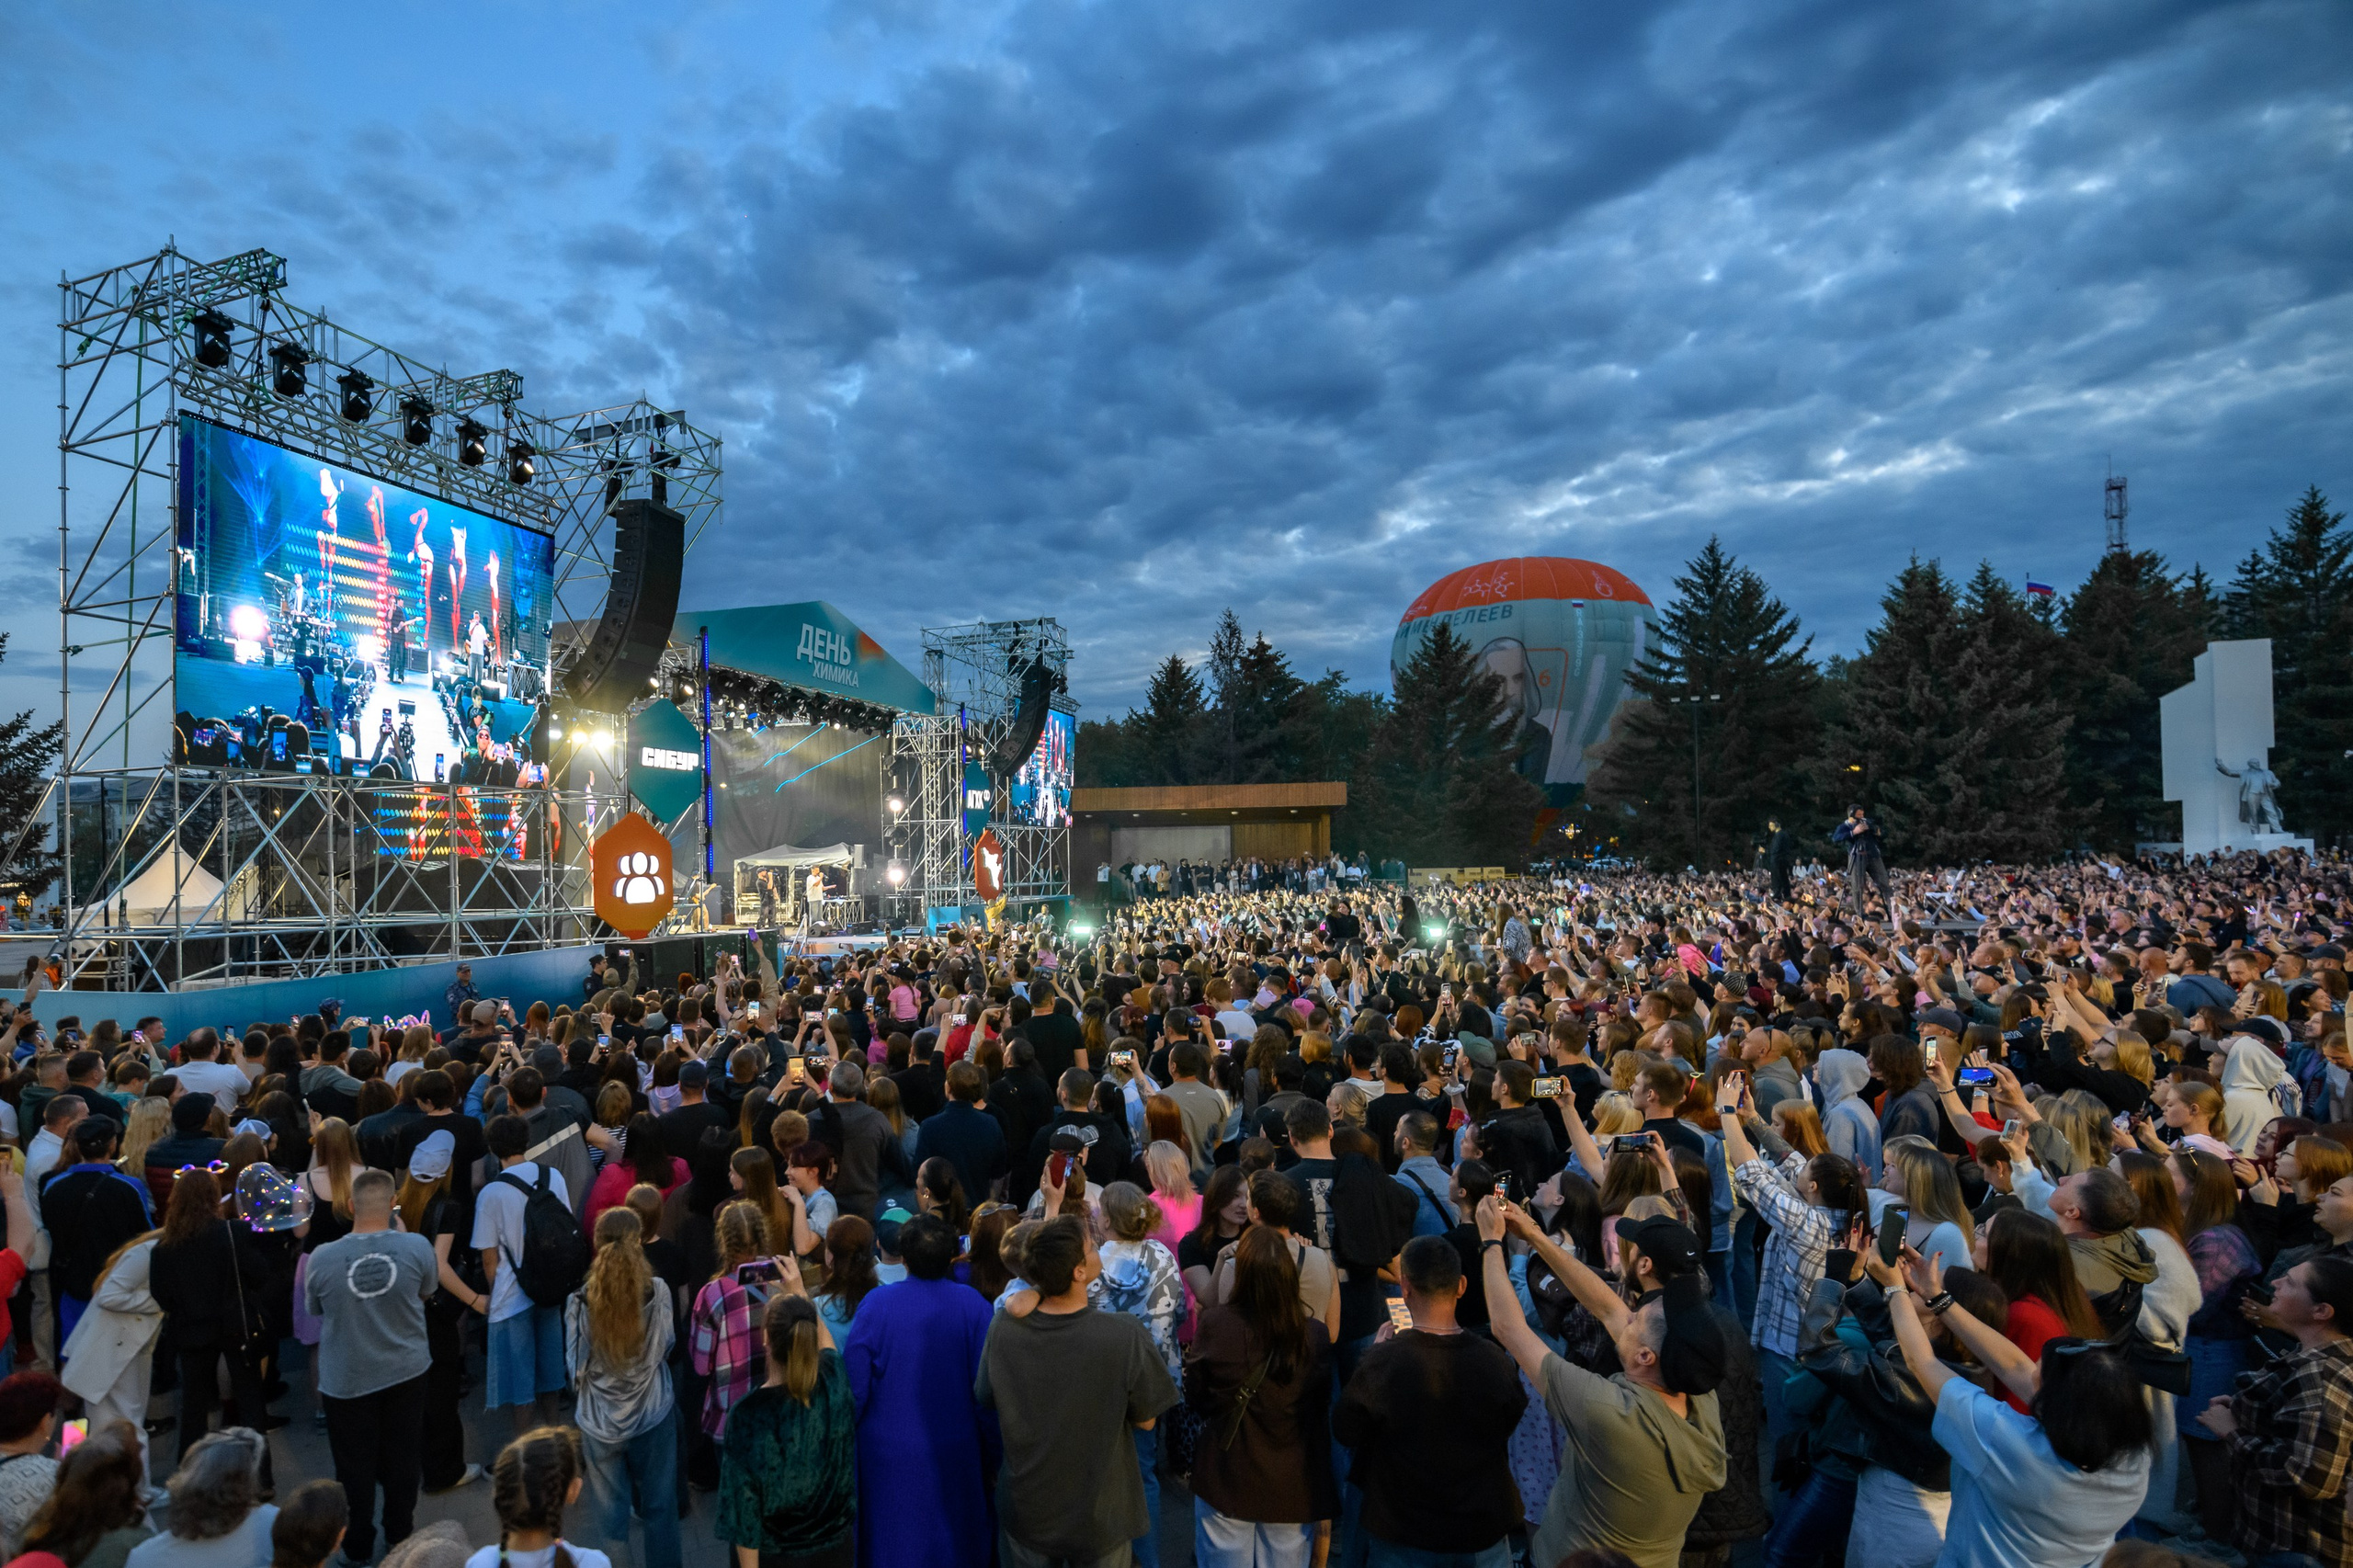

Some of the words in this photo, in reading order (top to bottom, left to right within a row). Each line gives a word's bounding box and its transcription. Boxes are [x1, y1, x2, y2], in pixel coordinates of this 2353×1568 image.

[796, 623, 851, 666] ДЕНЬ
[813, 660, 859, 688] ХИМИКА
[1539, 669, 1551, 687] 6
[642, 746, 699, 771] СИБУР
